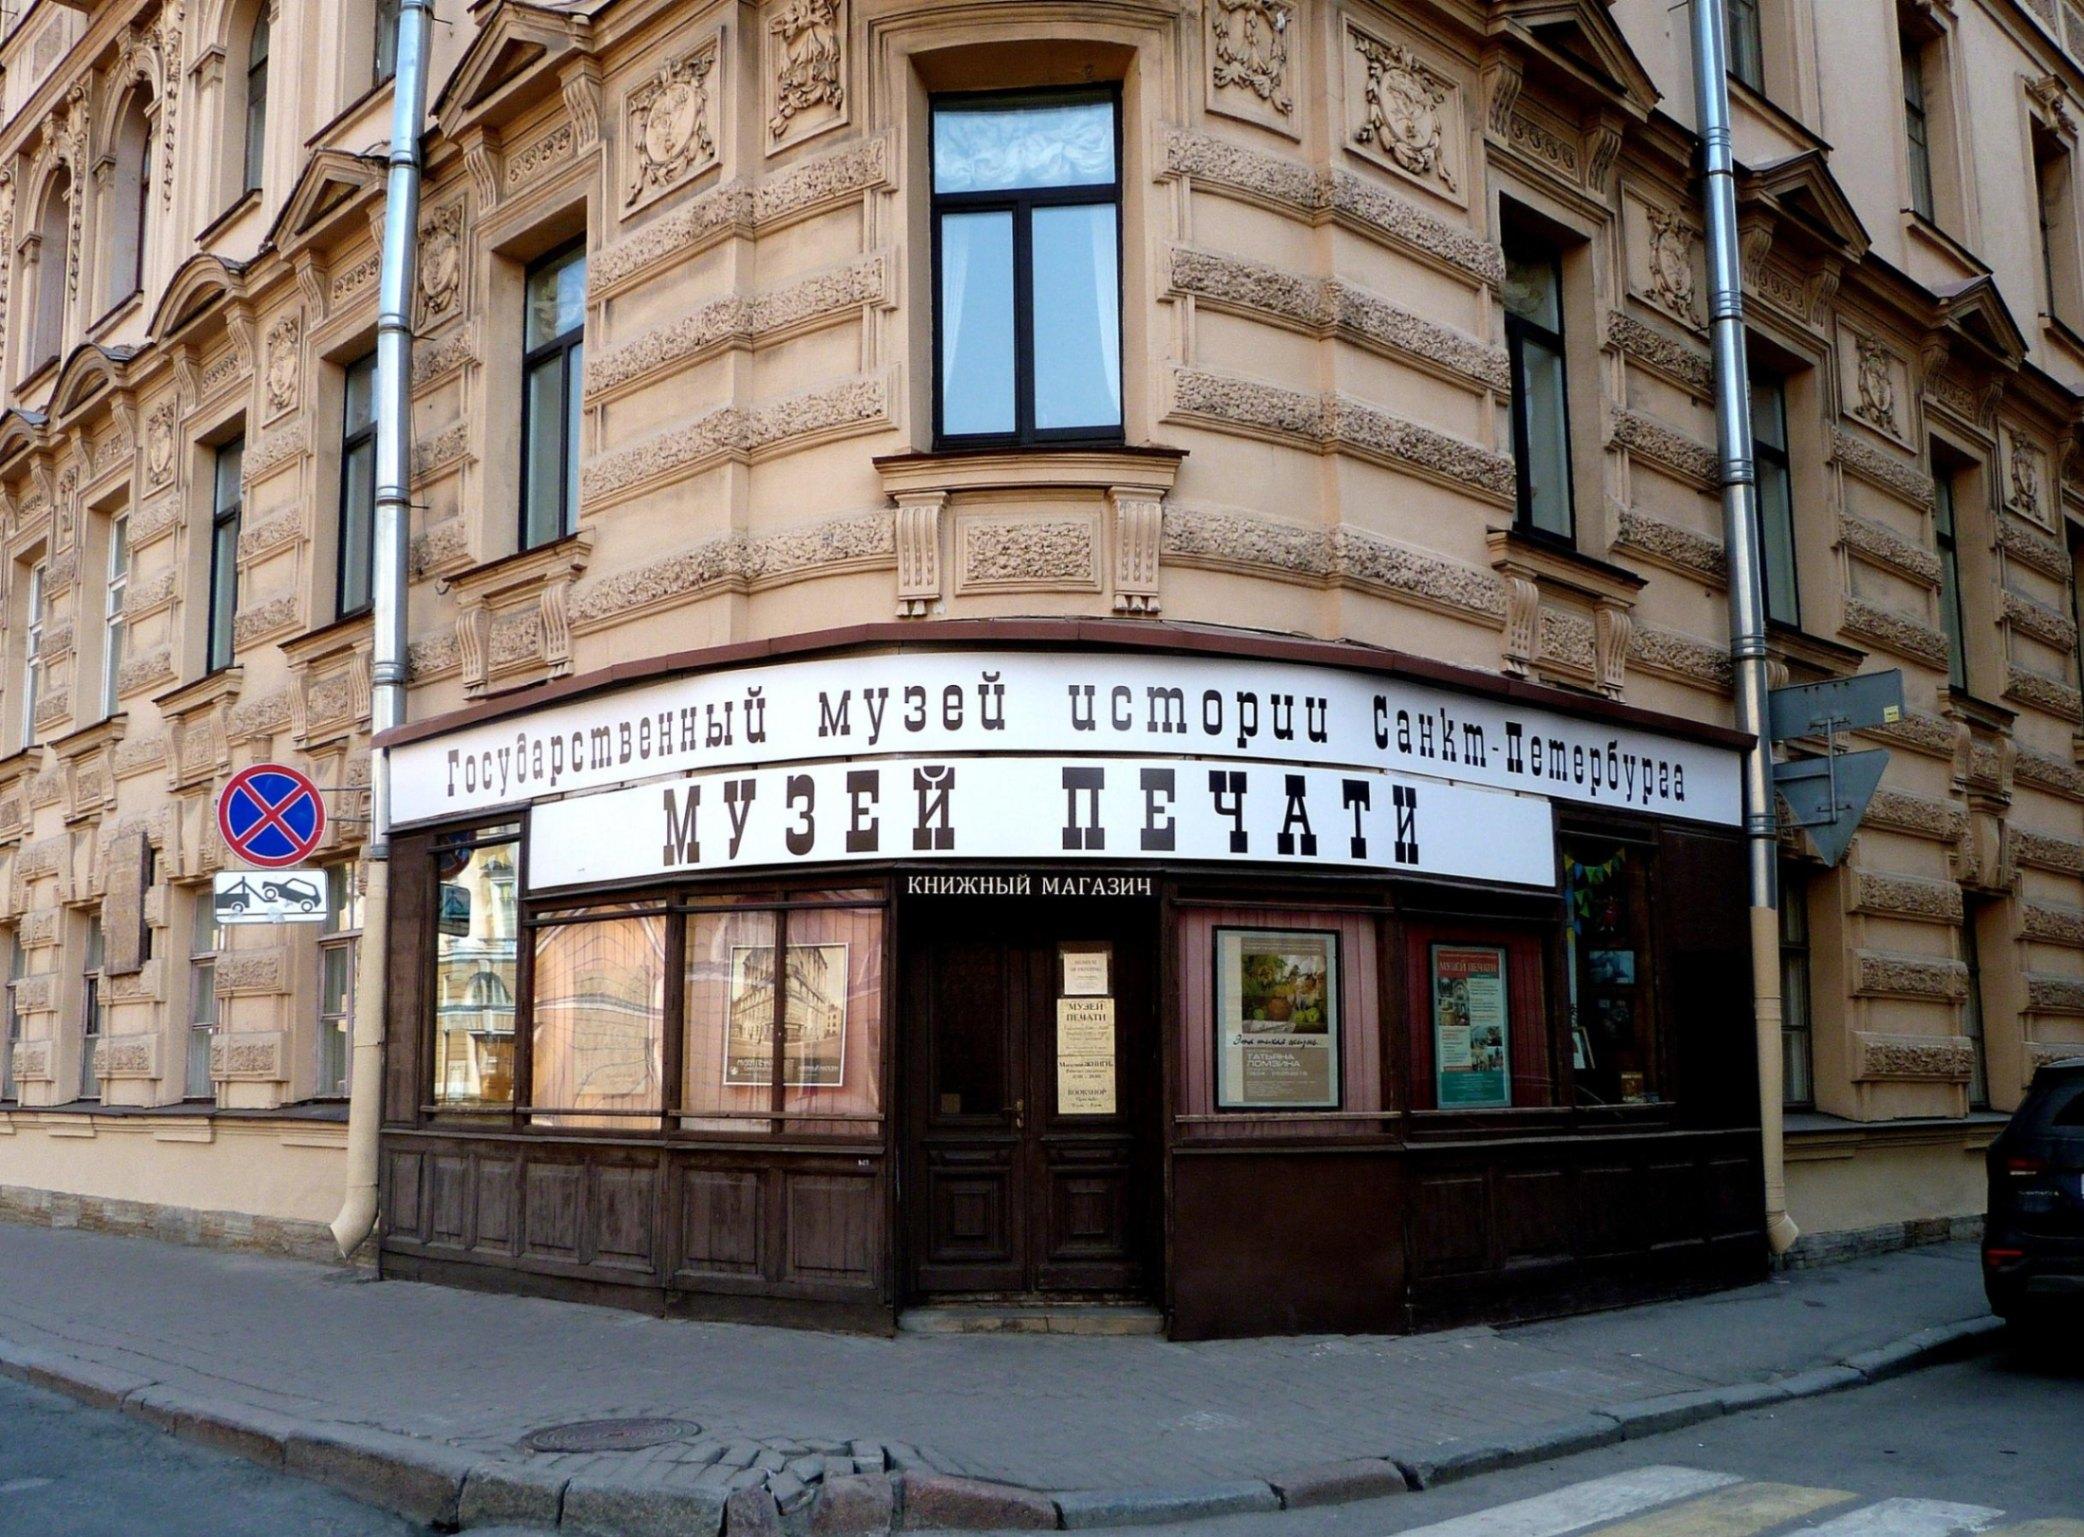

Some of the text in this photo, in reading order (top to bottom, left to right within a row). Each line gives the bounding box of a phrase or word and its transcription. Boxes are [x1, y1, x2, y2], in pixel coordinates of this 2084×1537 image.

[447, 672, 1686, 806] Государственный музей истории Санкт-Петербурга
[663, 766, 1419, 867] МУЗЕЙ ПЕЧАТИ
[907, 874, 1031, 895] КНИЖНЫЙ
[1069, 1000, 1104, 1011] МУЗЕЙ
